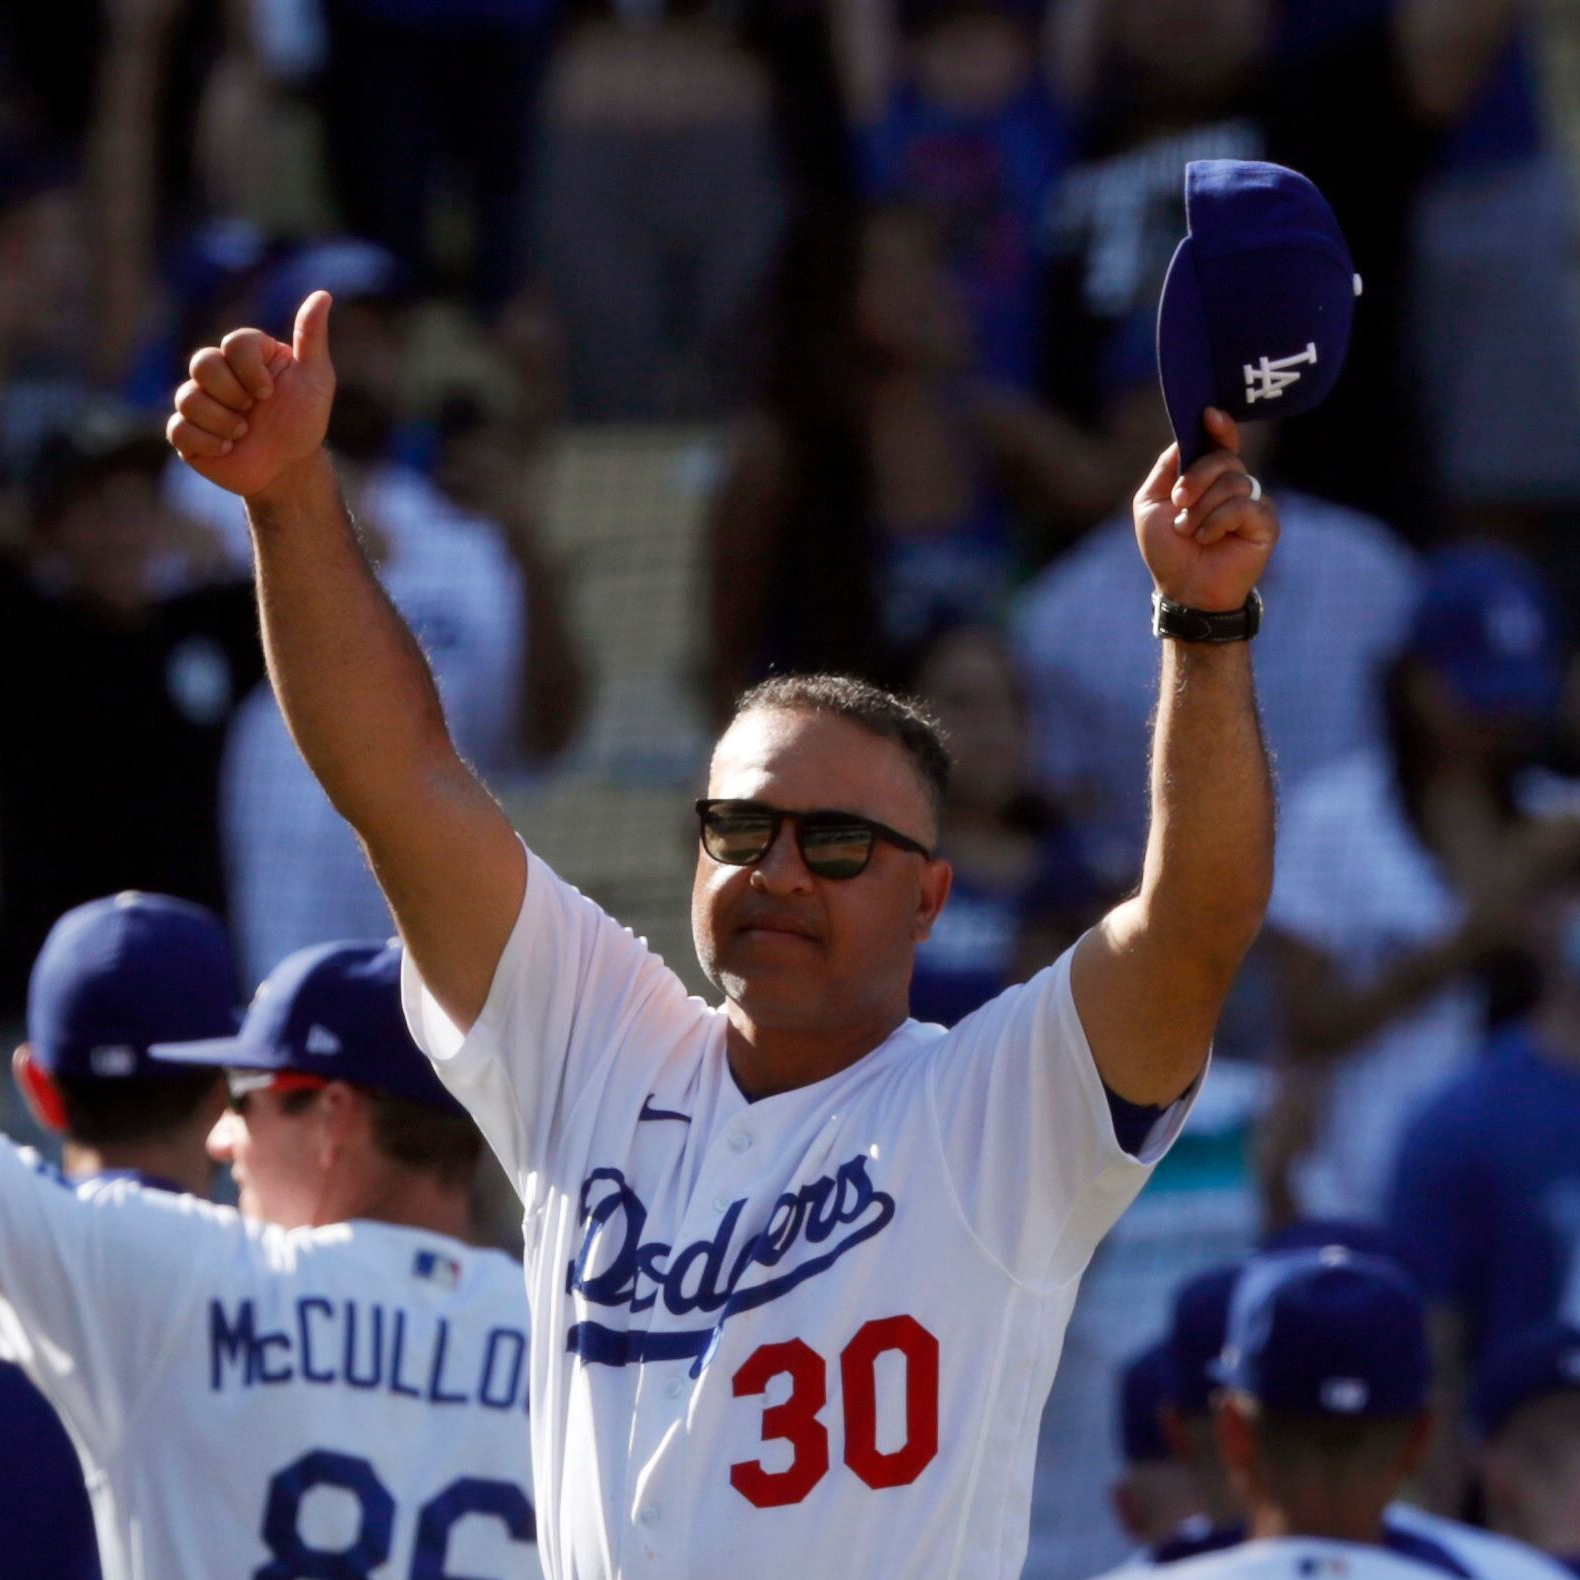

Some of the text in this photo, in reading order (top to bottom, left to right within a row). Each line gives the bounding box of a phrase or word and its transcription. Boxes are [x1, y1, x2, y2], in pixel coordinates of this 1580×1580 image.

[1242, 341, 1318, 405] LA
[209, 1297, 531, 1416] McCULLO
[729, 1313, 940, 1509] 30
